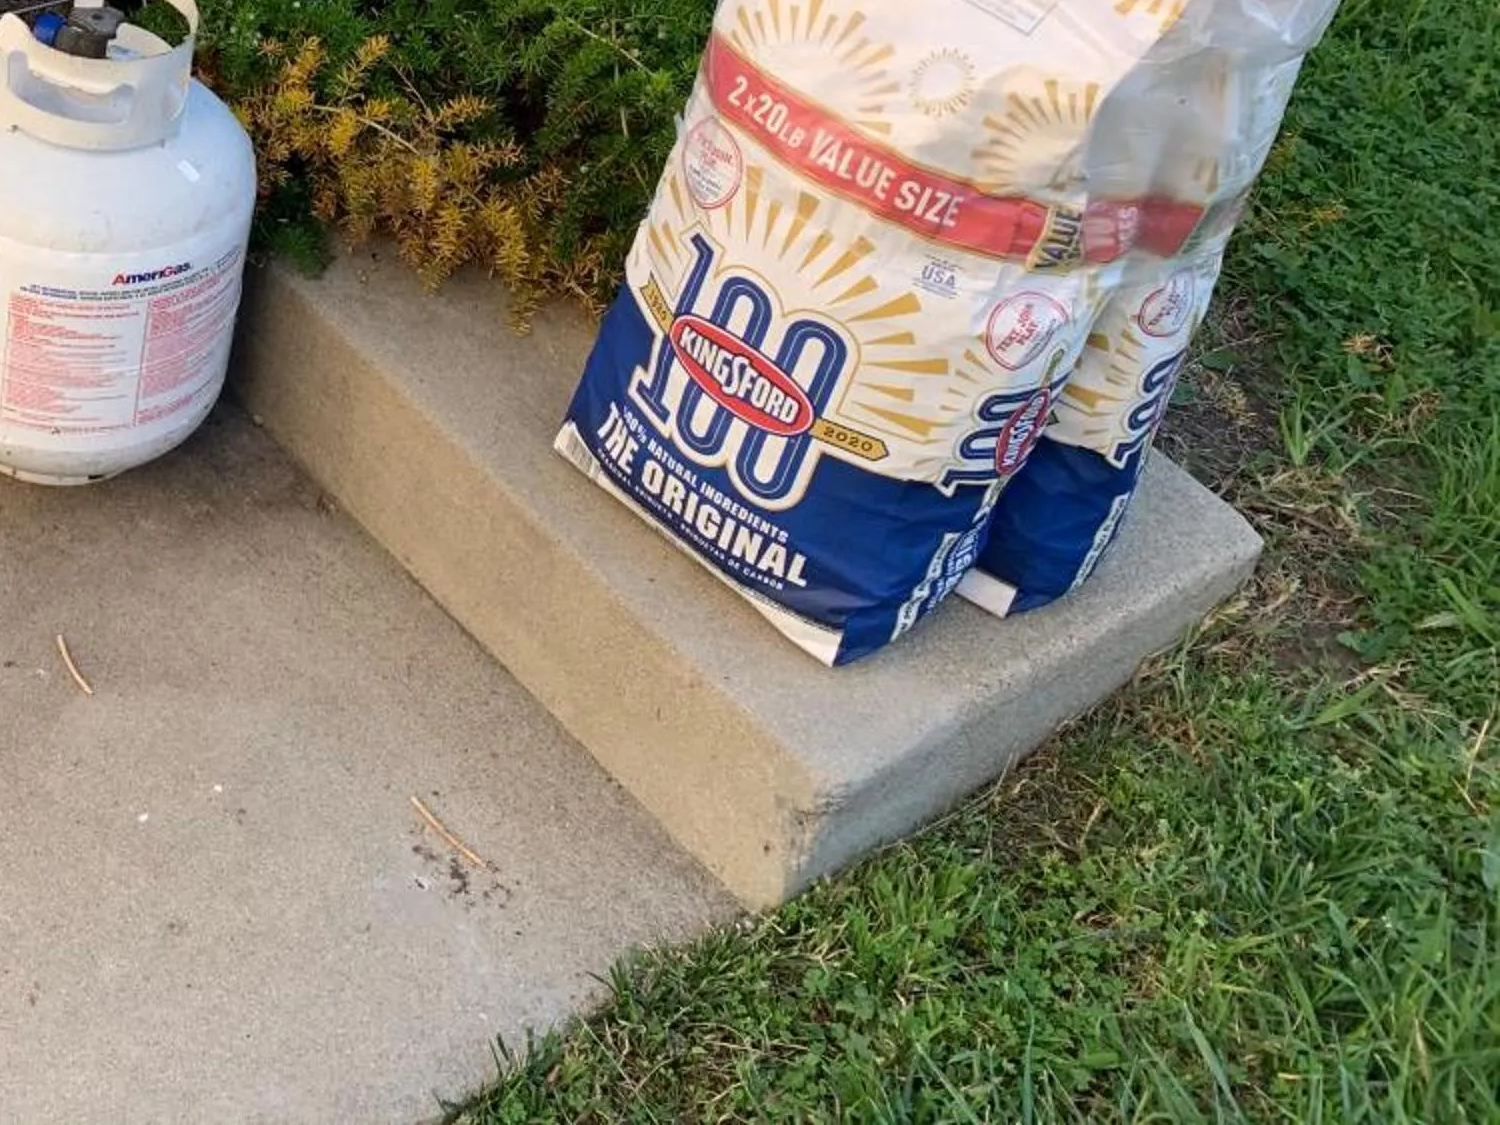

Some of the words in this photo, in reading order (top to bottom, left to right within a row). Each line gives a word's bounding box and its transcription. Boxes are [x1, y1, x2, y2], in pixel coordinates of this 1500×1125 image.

[807, 127, 896, 201] VALUE
[894, 180, 965, 228] SIZE
[112, 262, 193, 287] AmeriGas
[921, 265, 956, 289] USA
[680, 326, 799, 424] KINGSFORD
[821, 426, 875, 454] 2020
[597, 401, 640, 475] THE
[641, 459, 807, 588] ORIGINAL
[647, 438, 698, 488] NATURAL
[700, 481, 790, 544] INGREDIENTS
